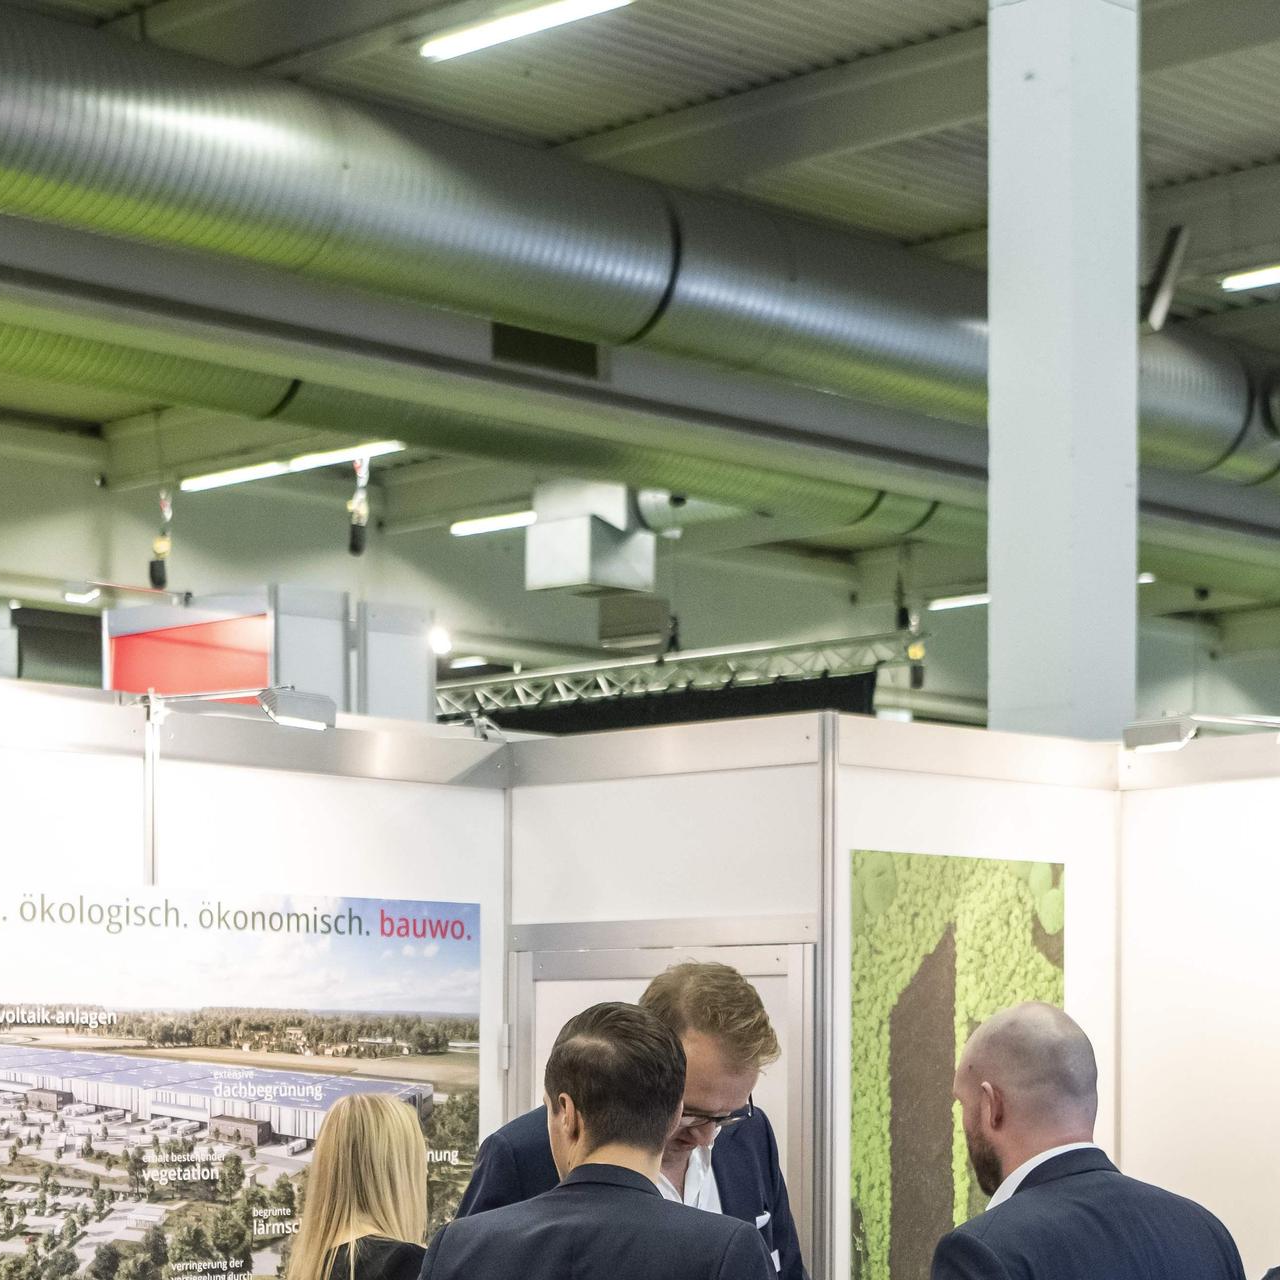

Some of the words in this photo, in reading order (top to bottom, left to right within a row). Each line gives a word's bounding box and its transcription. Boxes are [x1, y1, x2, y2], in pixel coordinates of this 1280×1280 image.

[19, 893, 188, 934] ökologisch.
[198, 901, 371, 937] ökonomisch.
[379, 908, 471, 941] bauwo.
[214, 1070, 255, 1081] extensive
[142, 1151, 169, 1163] erhalt
[171, 1152, 225, 1163] bestehender
[142, 1163, 219, 1186] vegetation
[171, 1259, 227, 1273] verringerung
[230, 1257, 244, 1269] der
